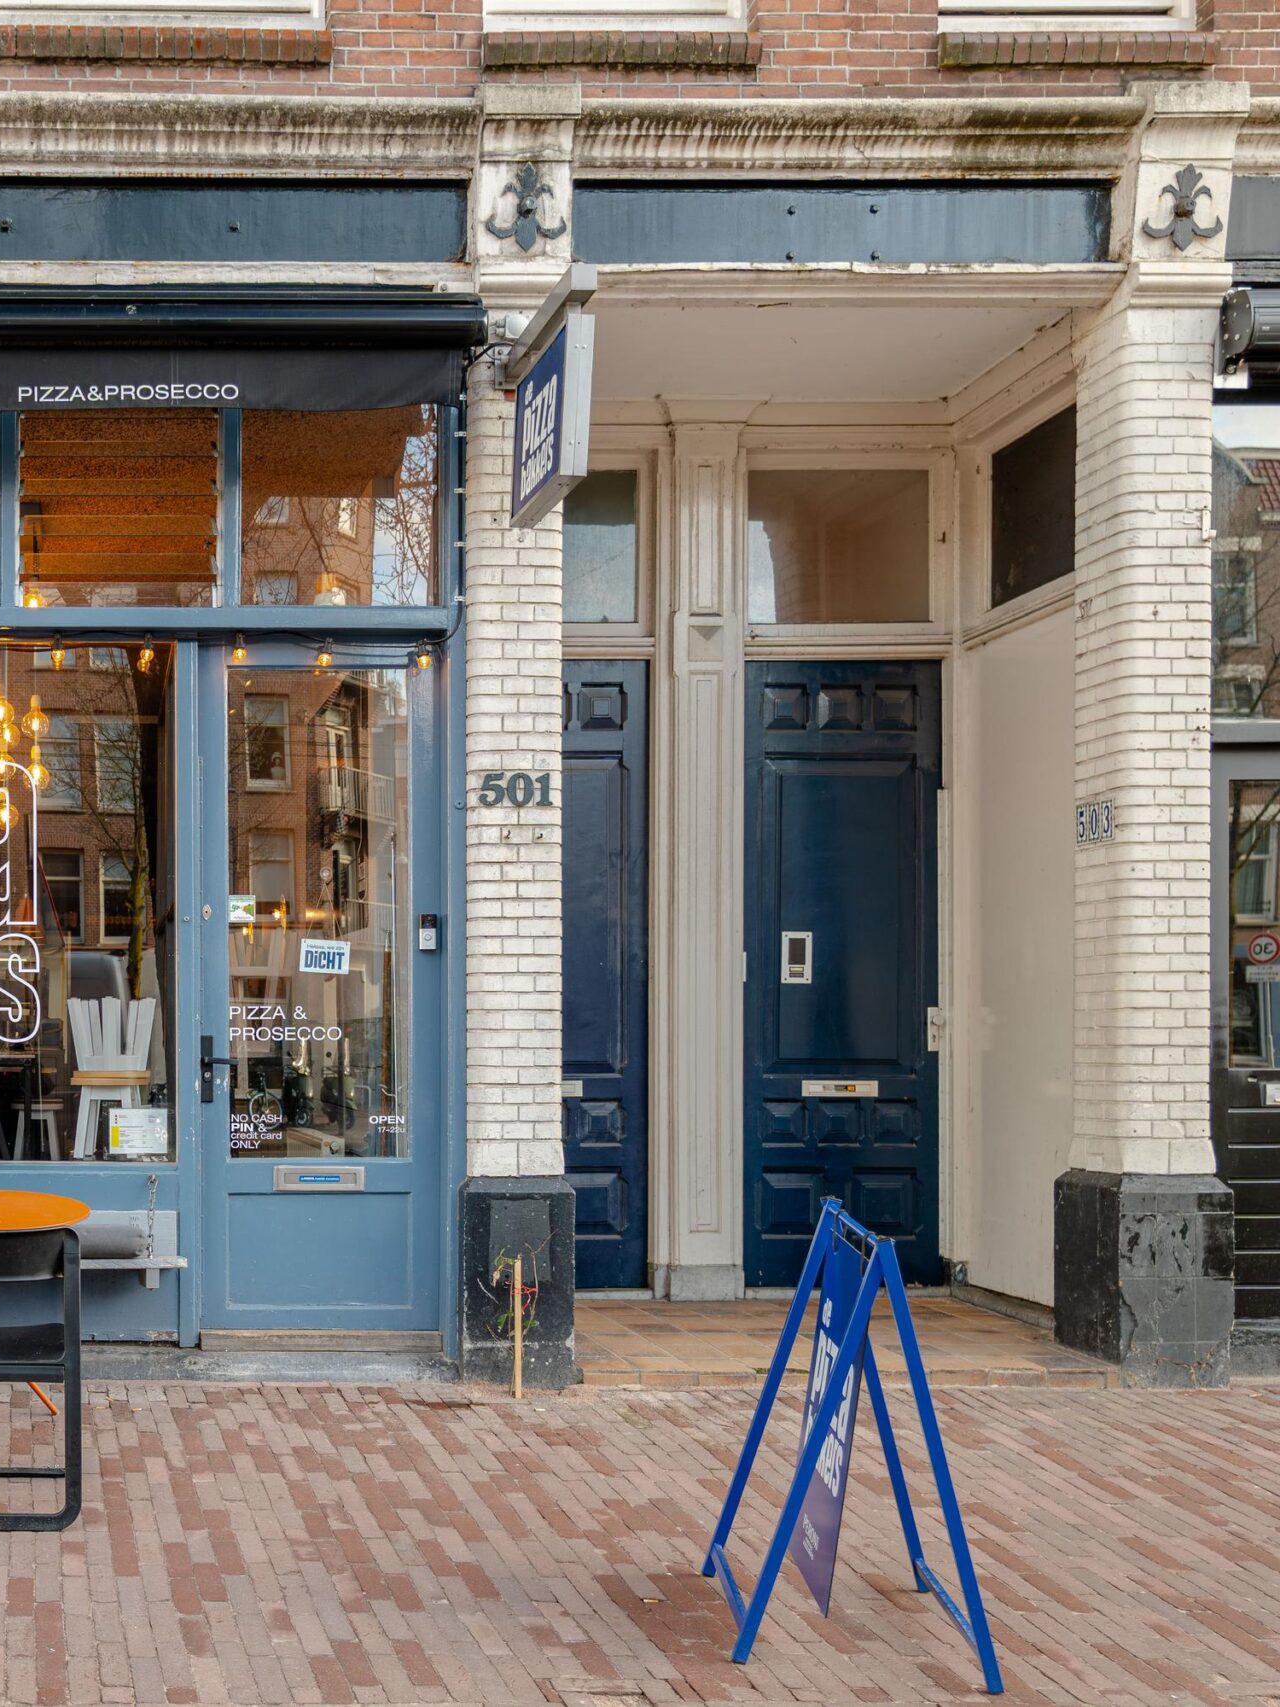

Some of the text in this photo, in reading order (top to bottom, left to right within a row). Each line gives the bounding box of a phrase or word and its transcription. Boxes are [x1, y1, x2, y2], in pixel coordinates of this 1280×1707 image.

[18, 384, 239, 402] PIZZA&PROSECCO
[520, 432, 554, 500] bakkers
[478, 771, 553, 807] 501
[1078, 804, 1110, 838] 503
[229, 1005, 308, 1020] PIZZA &
[229, 1026, 342, 1041] PROSECCO
[231, 1114, 283, 1123] NO CASH
[369, 1115, 405, 1125] OPEN
[231, 1123, 267, 1132] PIN &
[230, 1132, 283, 1140] credit card
[230, 1140, 261, 1149] ONLY
[822, 1298, 832, 1328] de
